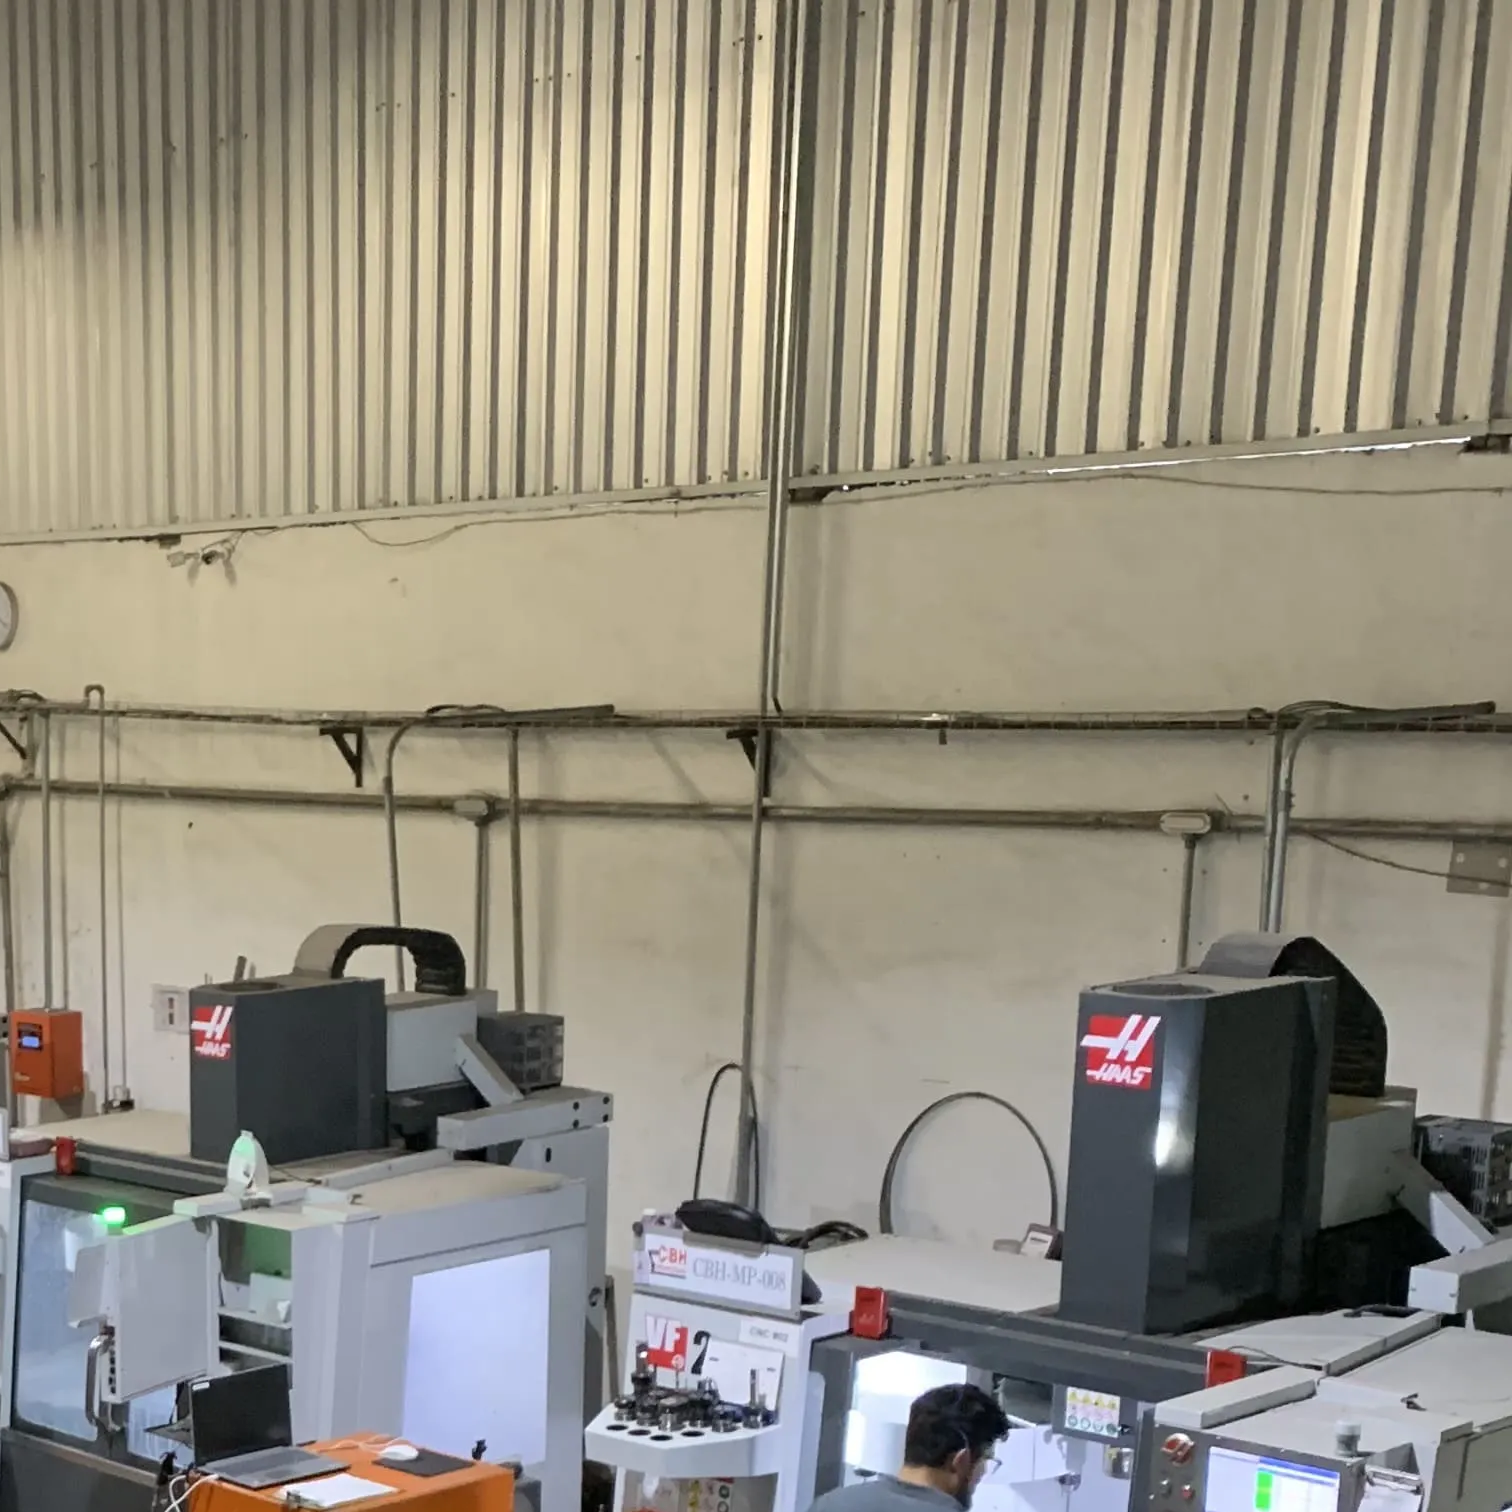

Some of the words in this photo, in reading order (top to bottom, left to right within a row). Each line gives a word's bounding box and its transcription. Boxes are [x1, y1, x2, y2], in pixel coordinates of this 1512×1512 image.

[1086, 1062, 1153, 1086] HAAS
[657, 1246, 687, 1264] CBH
[692, 1257, 787, 1292] CBH-MP-008
[691, 1330, 711, 1374] 2
